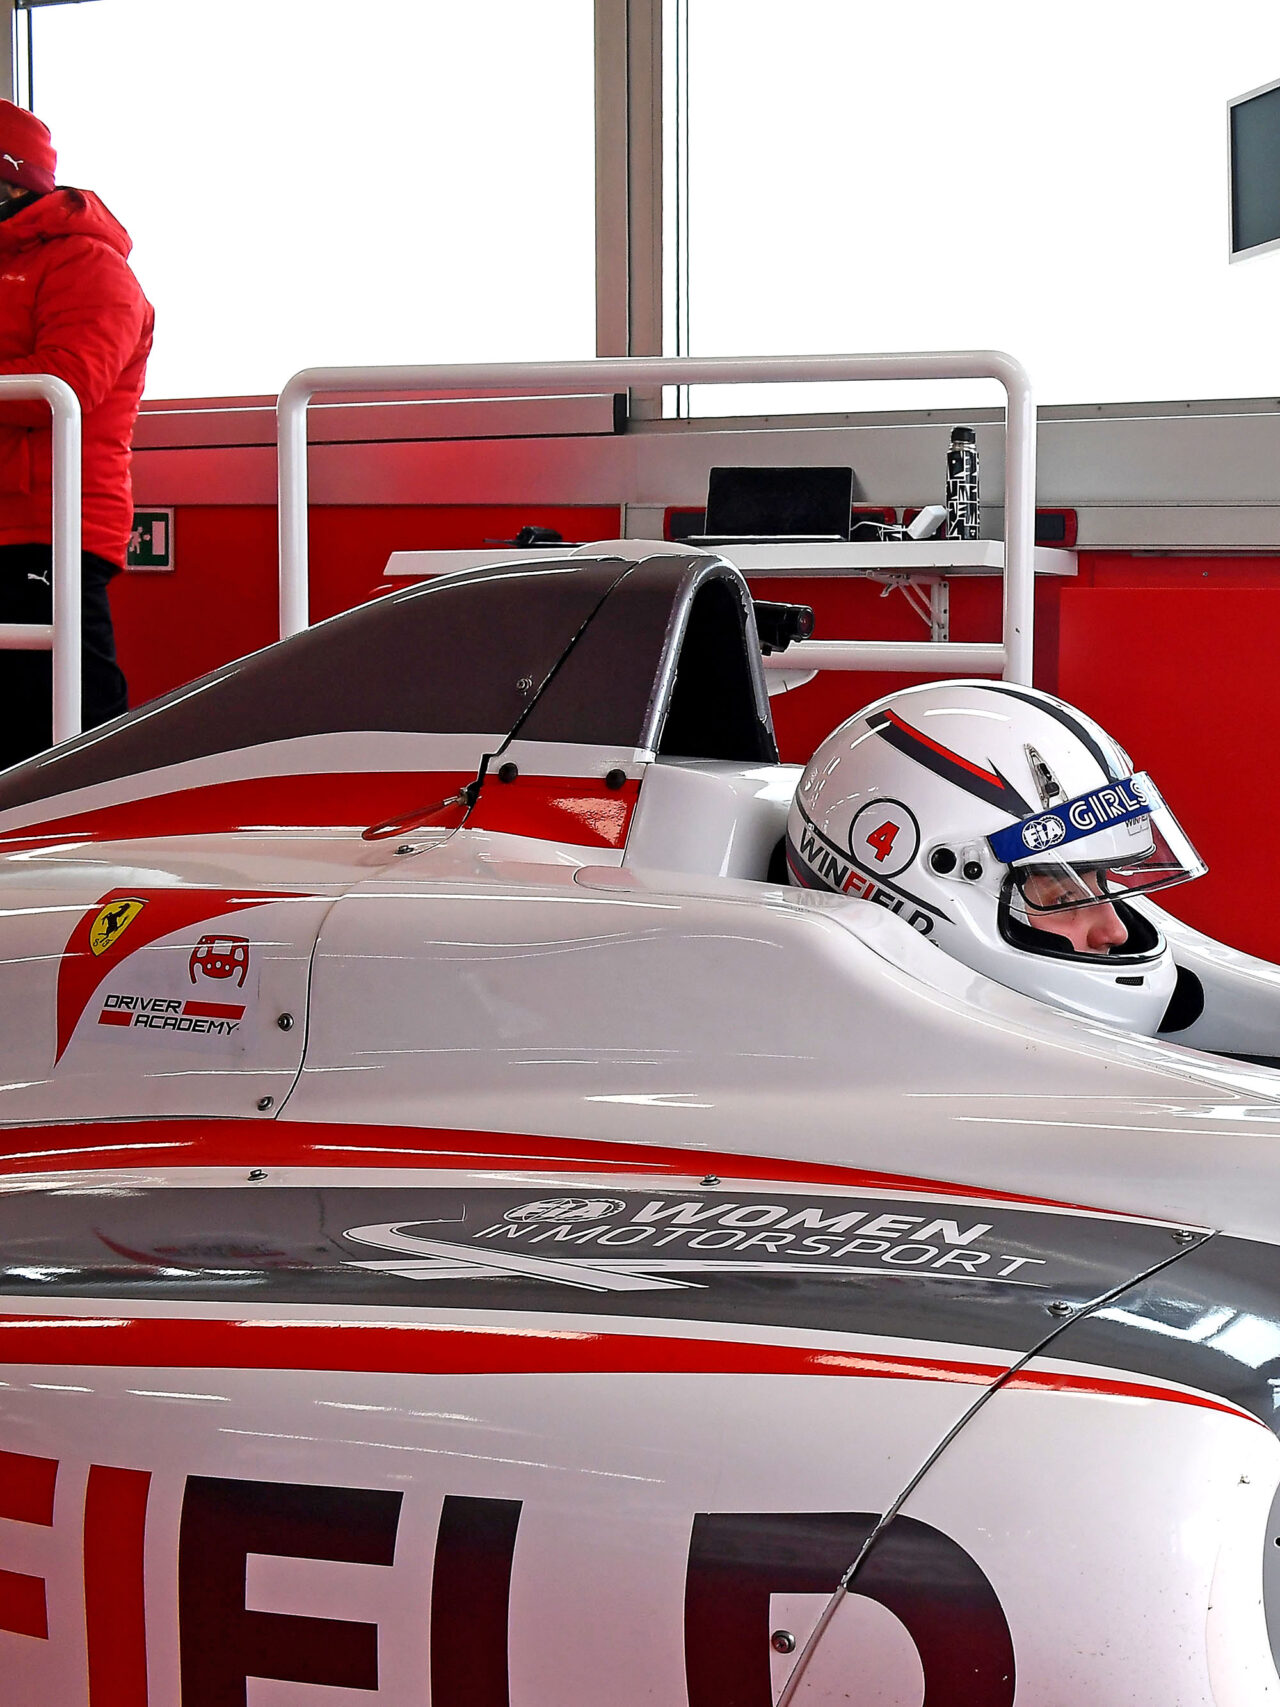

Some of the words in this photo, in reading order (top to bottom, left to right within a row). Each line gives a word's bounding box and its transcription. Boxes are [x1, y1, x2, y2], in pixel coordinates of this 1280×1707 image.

[1069, 780, 1150, 831] GIRLS
[866, 820, 901, 863] 4
[103, 994, 183, 1014] DRIVER
[133, 1013, 240, 1035] ACADEMY
[630, 1201, 994, 1246] WOMEN
[472, 1223, 539, 1239] IN
[528, 1224, 1047, 1277] MOTORSPORT
